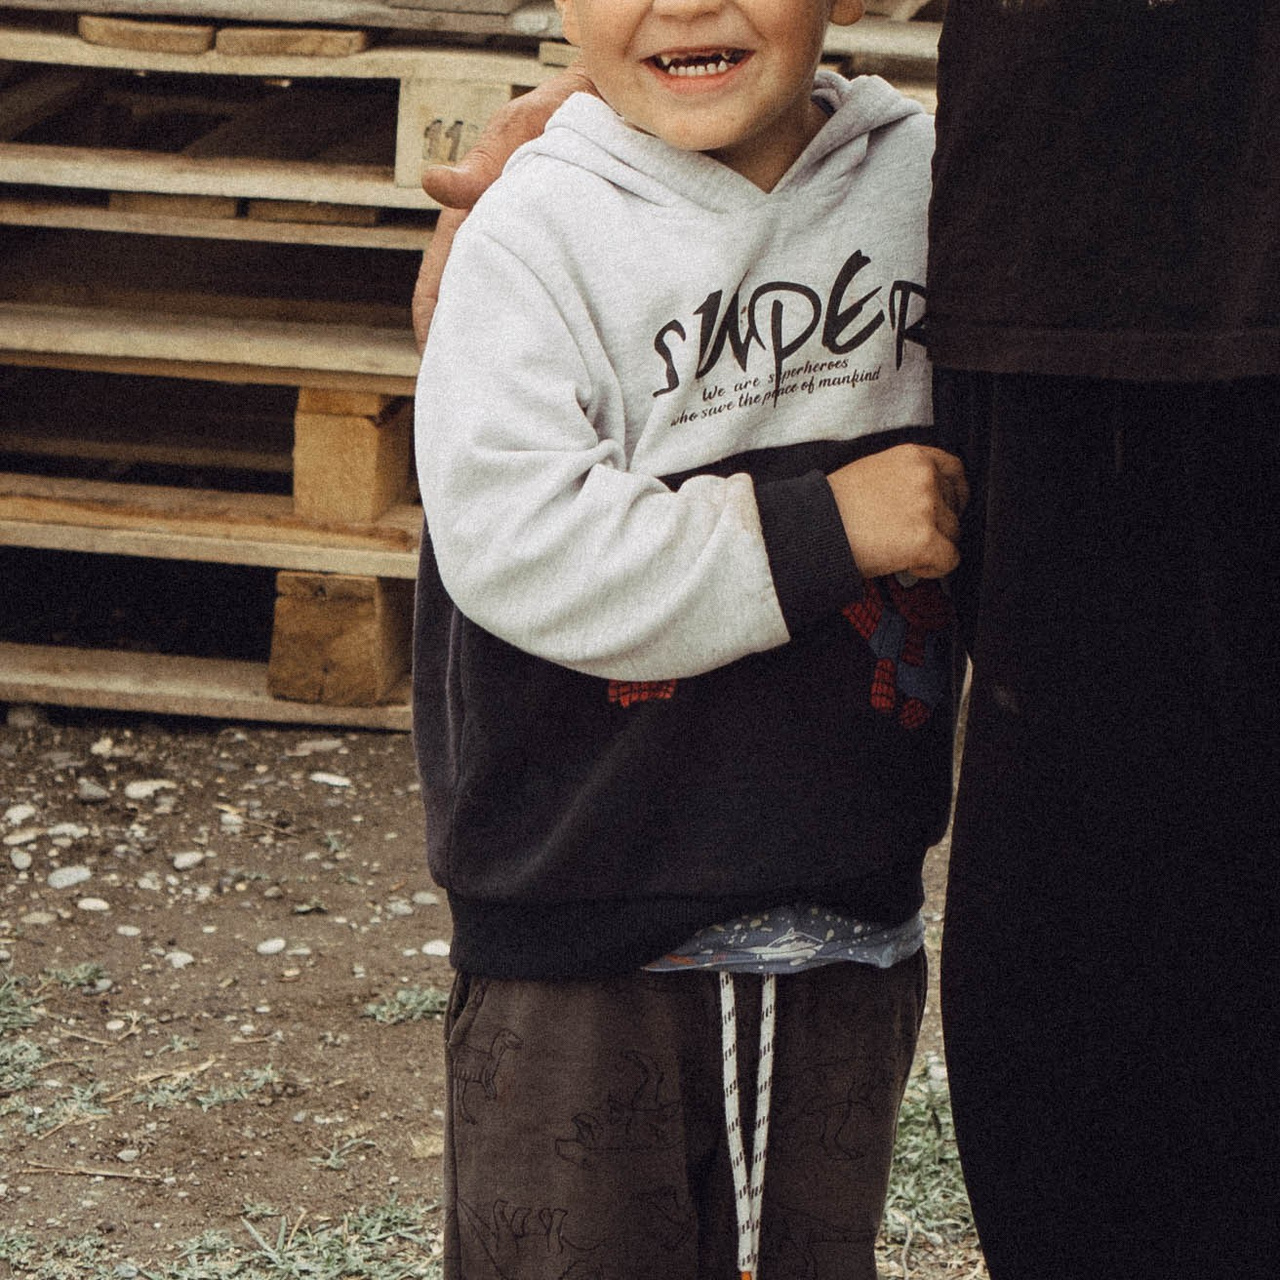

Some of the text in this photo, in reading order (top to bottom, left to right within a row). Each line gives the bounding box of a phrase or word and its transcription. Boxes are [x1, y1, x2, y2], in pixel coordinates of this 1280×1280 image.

[700, 400, 735, 419] save
[738, 393, 761, 408] the
[800, 376, 815, 394] of
[818, 366, 882, 388] mankind
[702, 359, 849, 402] We are sperheroes
